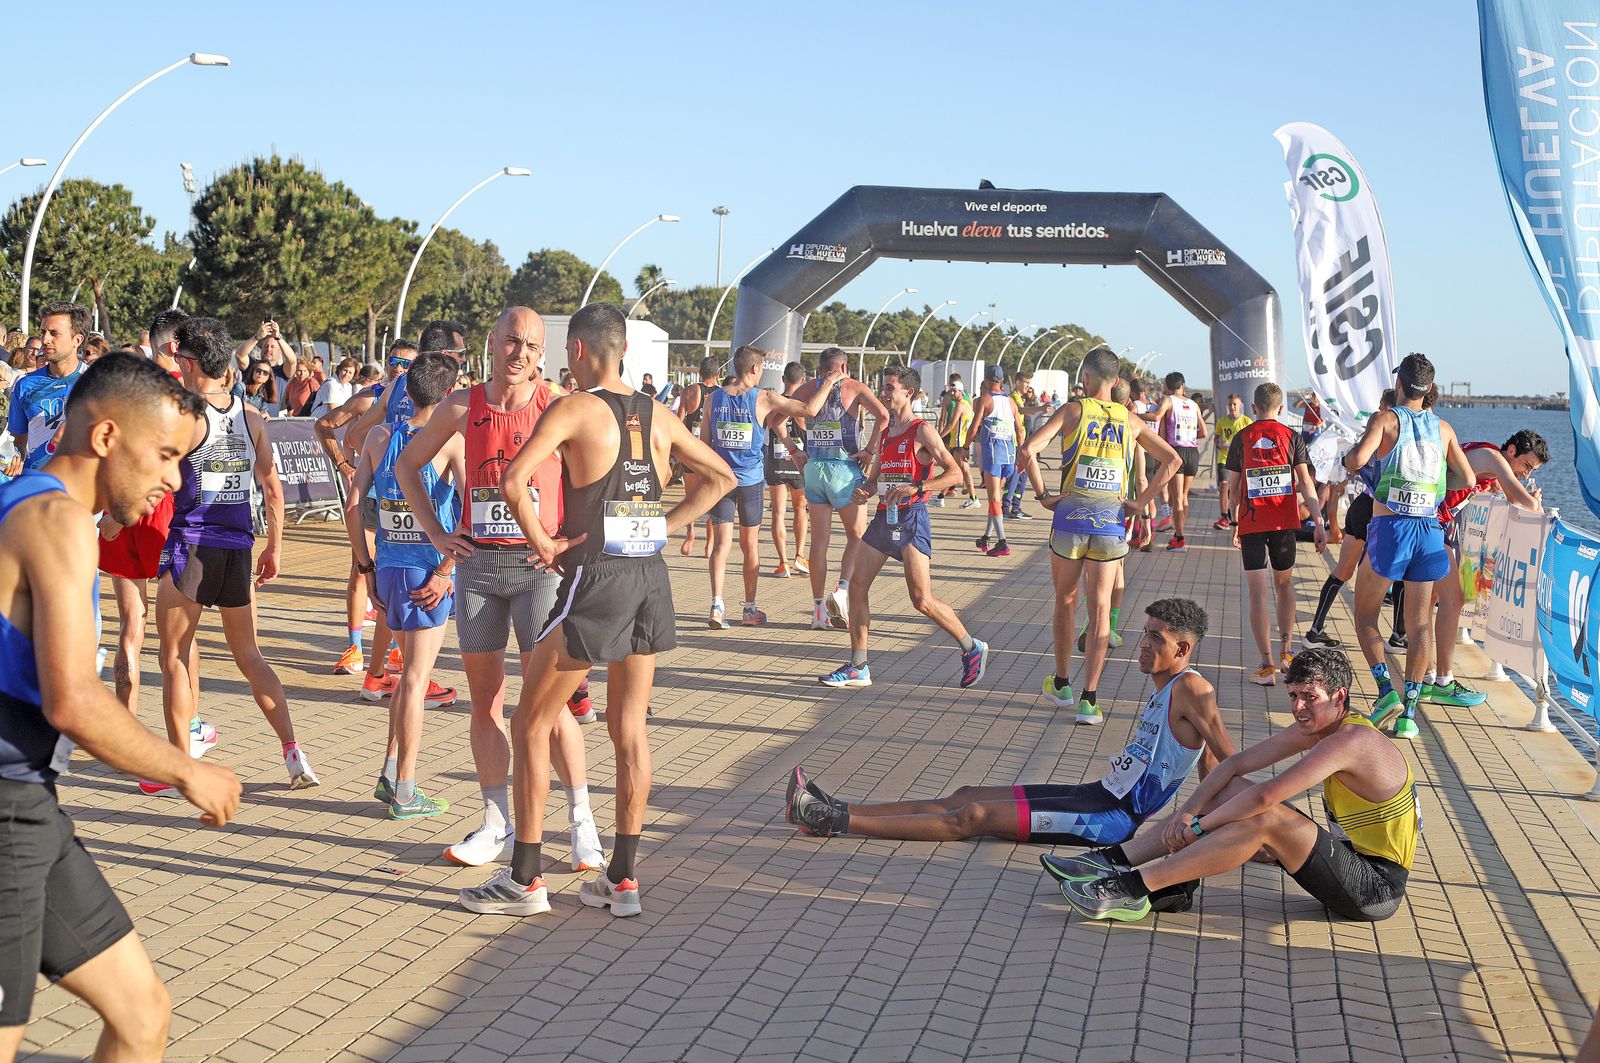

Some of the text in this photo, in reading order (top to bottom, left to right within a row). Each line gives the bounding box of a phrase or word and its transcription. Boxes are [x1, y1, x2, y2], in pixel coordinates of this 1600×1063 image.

[965, 201, 1047, 213] Vive el deporte
[901, 221, 1109, 239] Huelva eleva tus sentidos.
[816, 250, 846, 259] HUELVA
[1196, 254, 1226, 262] HUELVA
[763, 360, 785, 371] tidos
[1218, 357, 1251, 371] Huelva
[1219, 367, 1273, 382] tus sentido
[721, 430, 744, 440] M35
[813, 430, 835, 440] M35
[283, 457, 328, 473] DE HUELVA
[881, 458, 912, 469] diolanum
[1086, 466, 1116, 481] M35
[223, 474, 241, 490] 53
[625, 478, 651, 494] be plus
[1258, 476, 1280, 488] 104
[1398, 490, 1427, 505] M35
[490, 504, 514, 521] 68
[391, 514, 415, 530] 90
[1499, 610, 1524, 640] original
